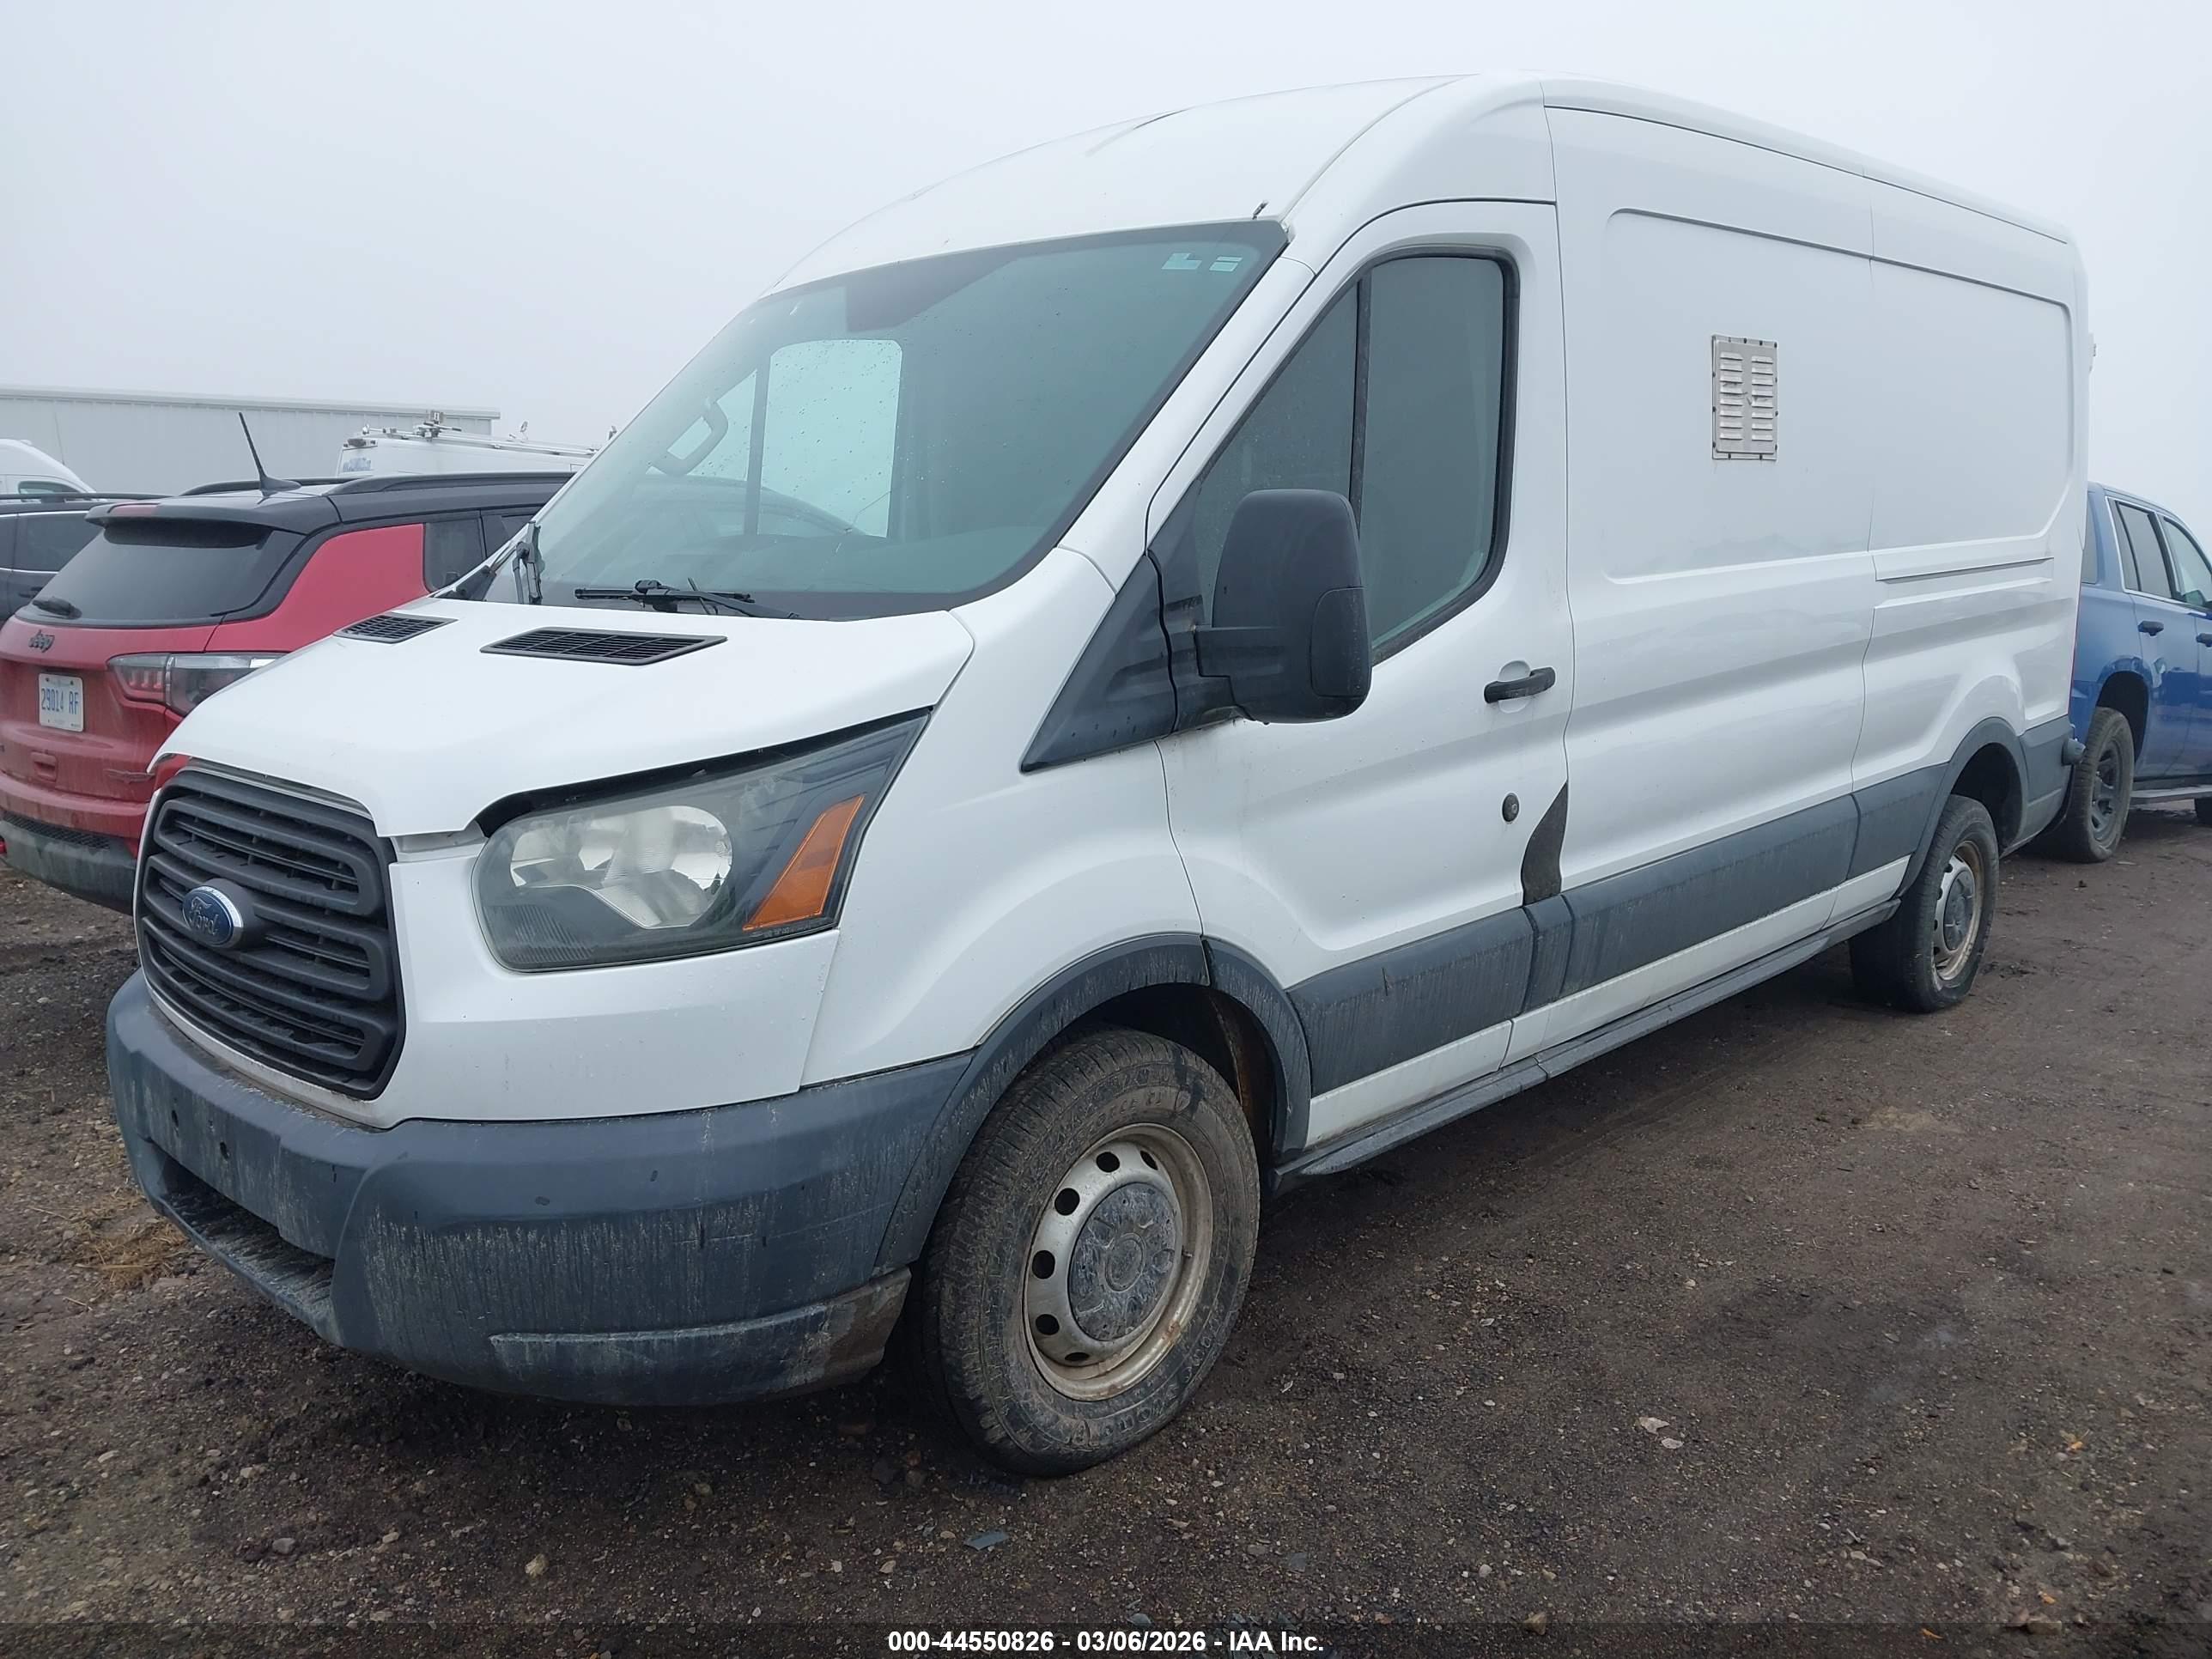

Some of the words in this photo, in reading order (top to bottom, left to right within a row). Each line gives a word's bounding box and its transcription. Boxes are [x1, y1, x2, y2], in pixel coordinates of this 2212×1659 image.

[28, 629, 55, 653] Jeep
[69, 691, 79, 714] RF
[188, 896, 219, 936] Ford
